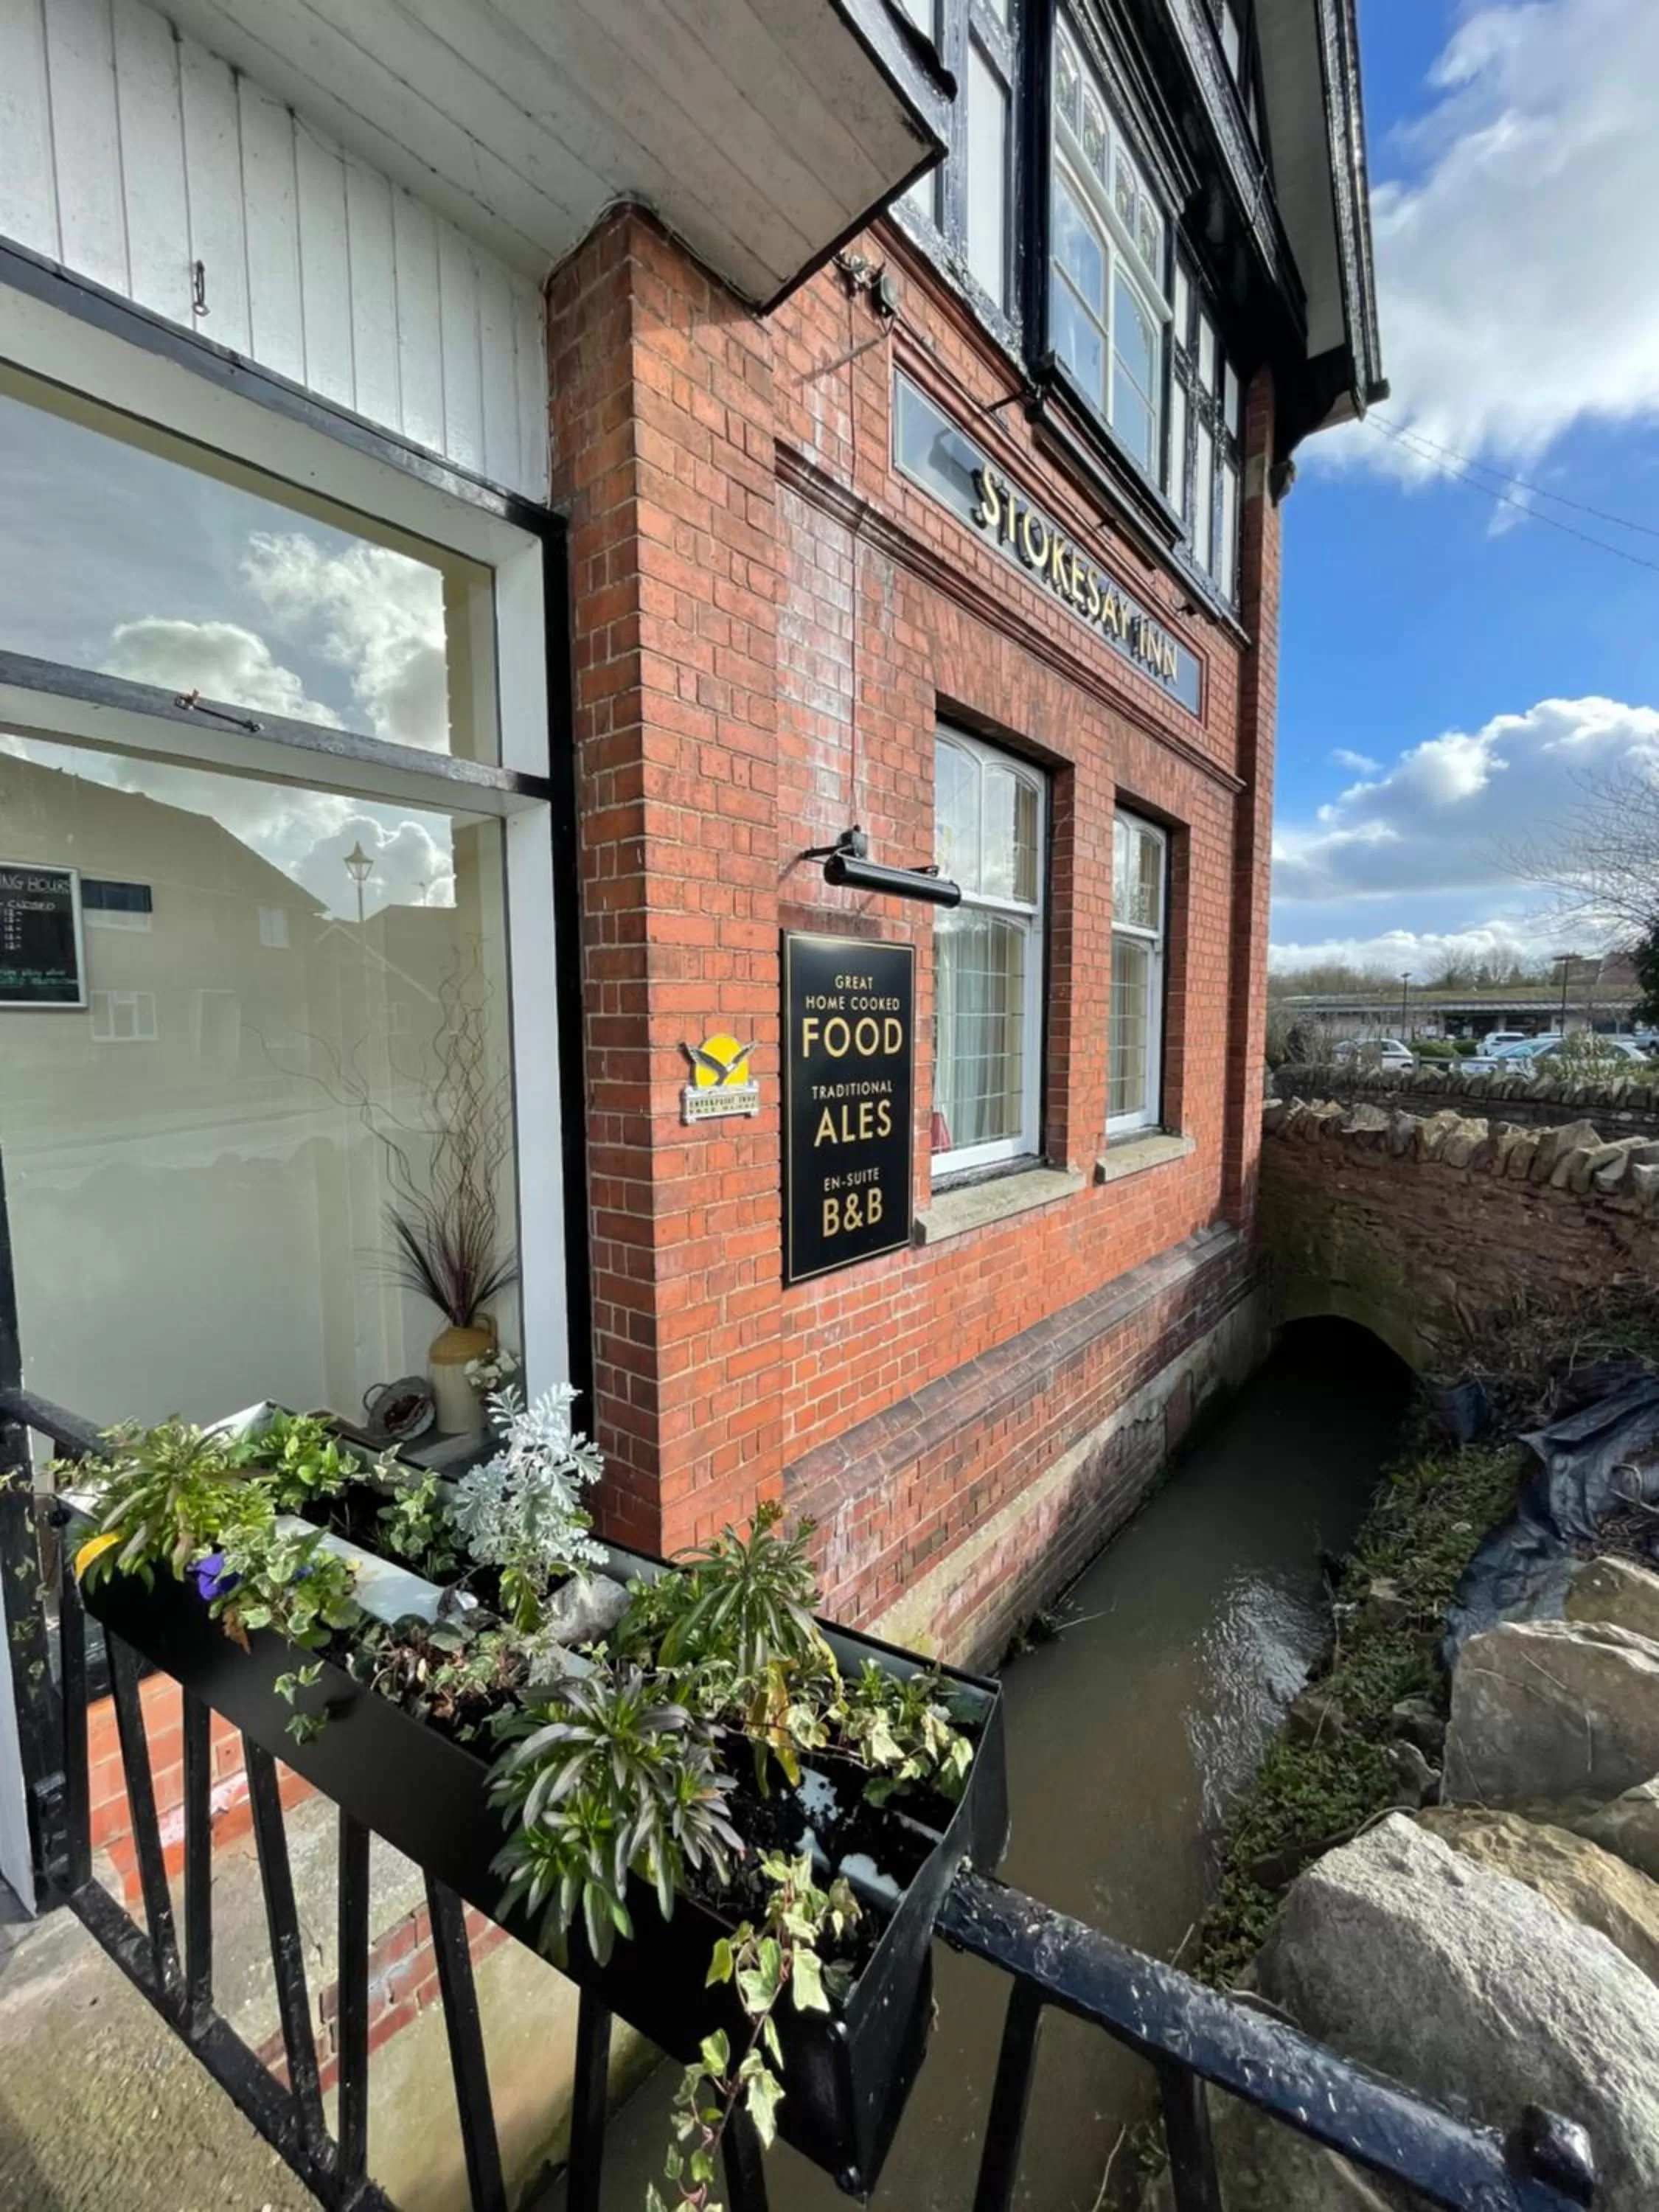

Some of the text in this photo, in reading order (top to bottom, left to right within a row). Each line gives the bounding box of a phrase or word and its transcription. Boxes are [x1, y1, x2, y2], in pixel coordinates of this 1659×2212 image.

[981, 459, 1178, 685] STOKESAY INN
[27, 875, 70, 894] HOURS
[835, 974, 874, 990] GREAT
[805, 995, 900, 1011] HOME COOKED
[802, 1017, 902, 1058] FOOD
[812, 1080, 893, 1100] TRADITIONAL
[813, 1099, 892, 1147] ALES
[824, 1167, 880, 1192] EN-SUITE
[823, 1186, 883, 1238] B&B
